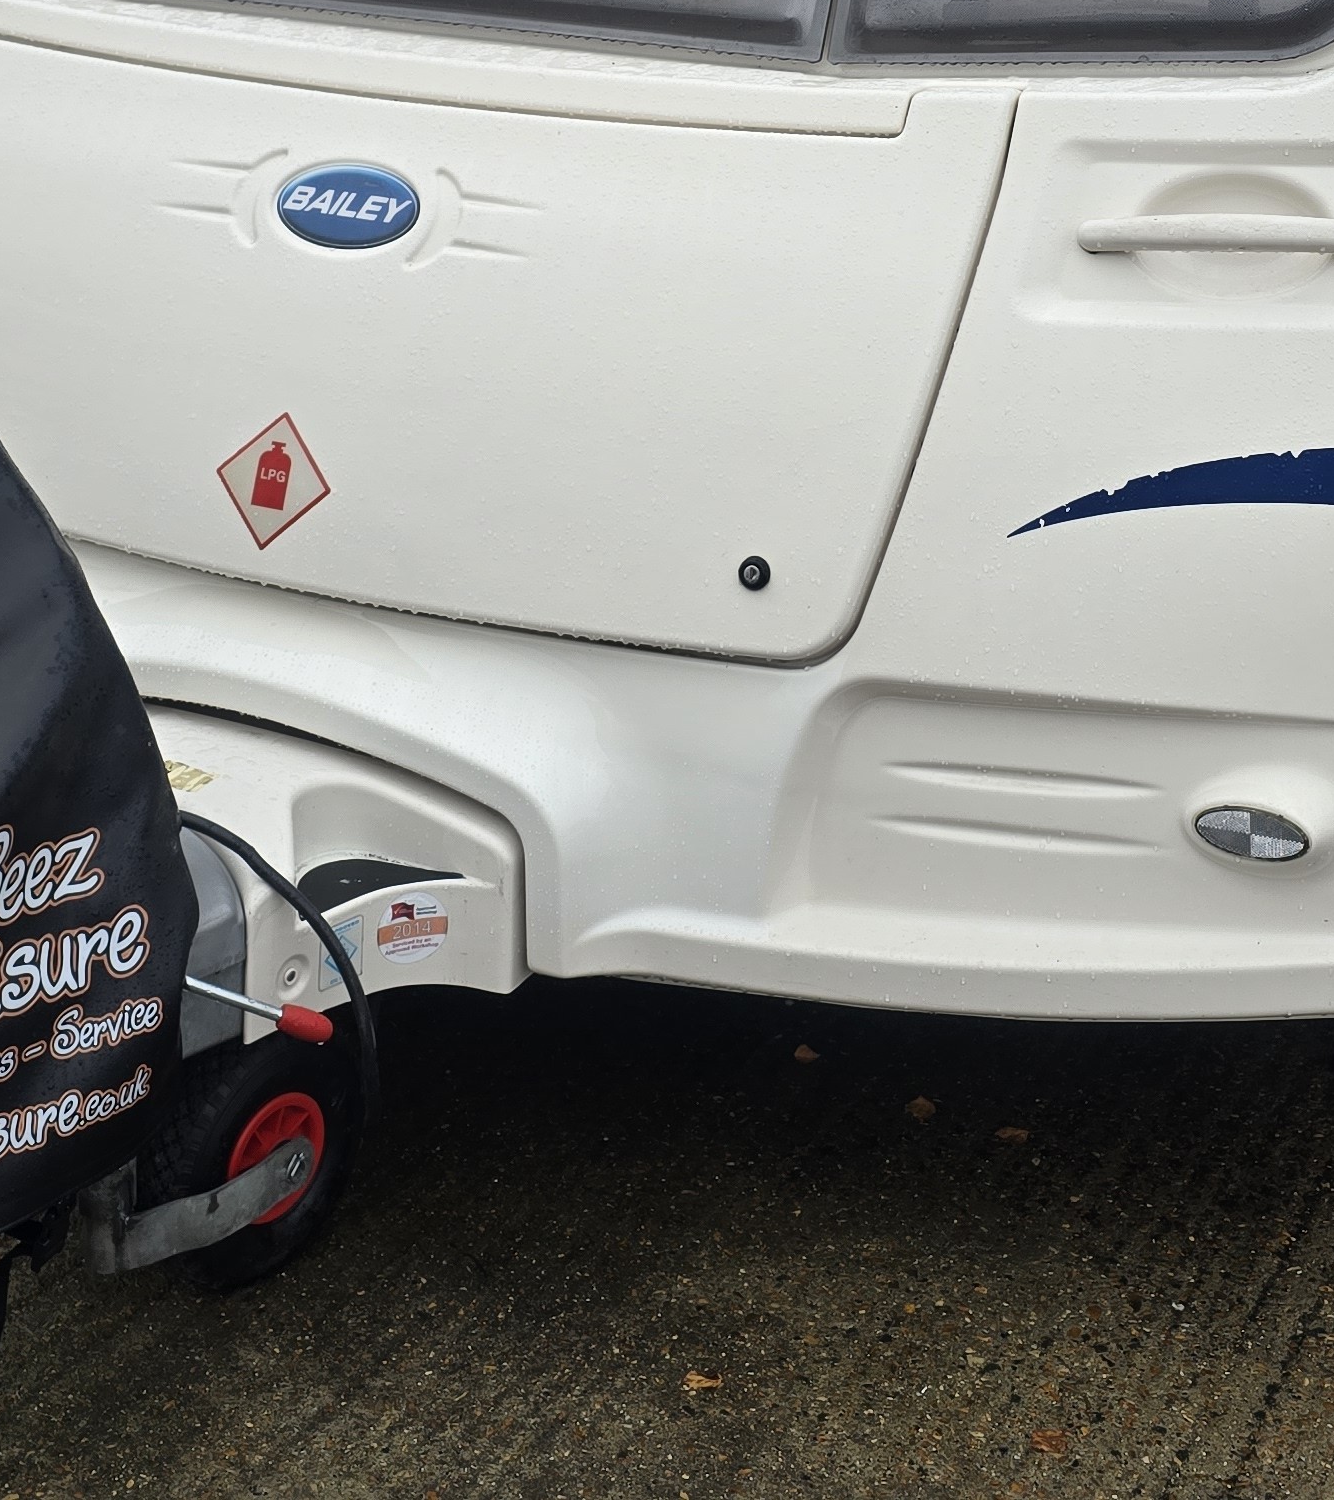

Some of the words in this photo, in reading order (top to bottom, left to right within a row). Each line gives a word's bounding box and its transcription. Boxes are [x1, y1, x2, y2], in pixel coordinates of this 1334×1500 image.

[282, 185, 412, 224] BAILEY
[259, 466, 287, 484] LPG
[393, 920, 431, 940] 2014
[50, 998, 162, 1057] Service
